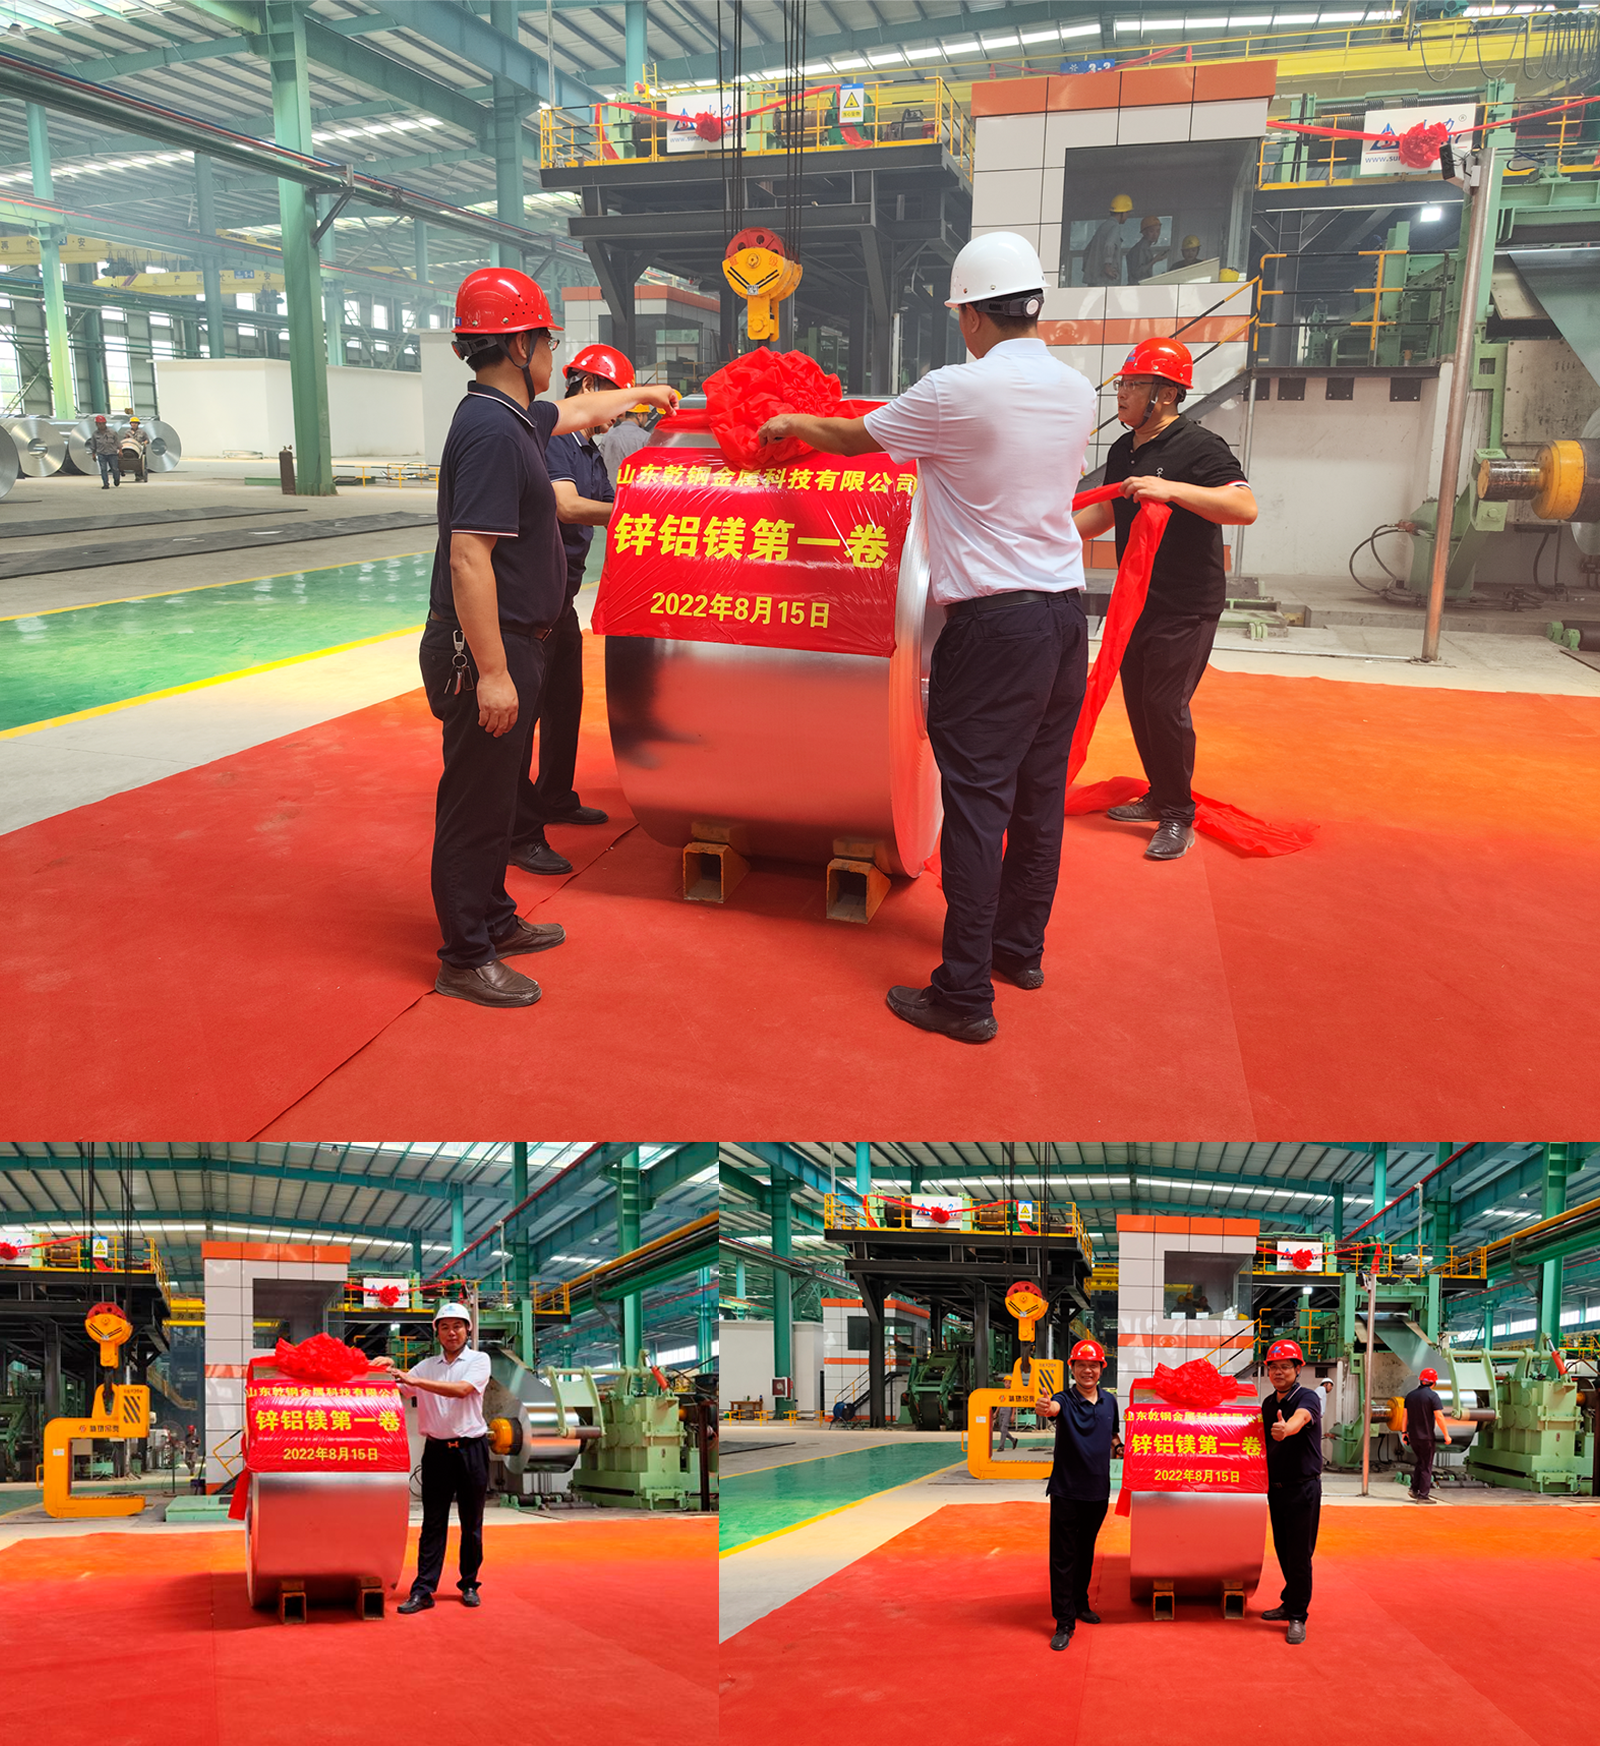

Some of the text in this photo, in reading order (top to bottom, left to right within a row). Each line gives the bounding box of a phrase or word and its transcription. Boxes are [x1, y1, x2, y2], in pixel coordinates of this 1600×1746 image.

[616, 464, 917, 497] 山东乾钢金属科技有限公司
[614, 512, 889, 569] 锌铝镁第一卷
[650, 592, 830, 628] 2022年8月15日
[256, 1410, 400, 1432] 锌铝镁第一卷
[283, 1447, 378, 1461] 2022年8月15日
[1131, 1434, 1262, 1456] 锌铝镁第一卷
[1154, 1469, 1240, 1483] 2022年8月15日
